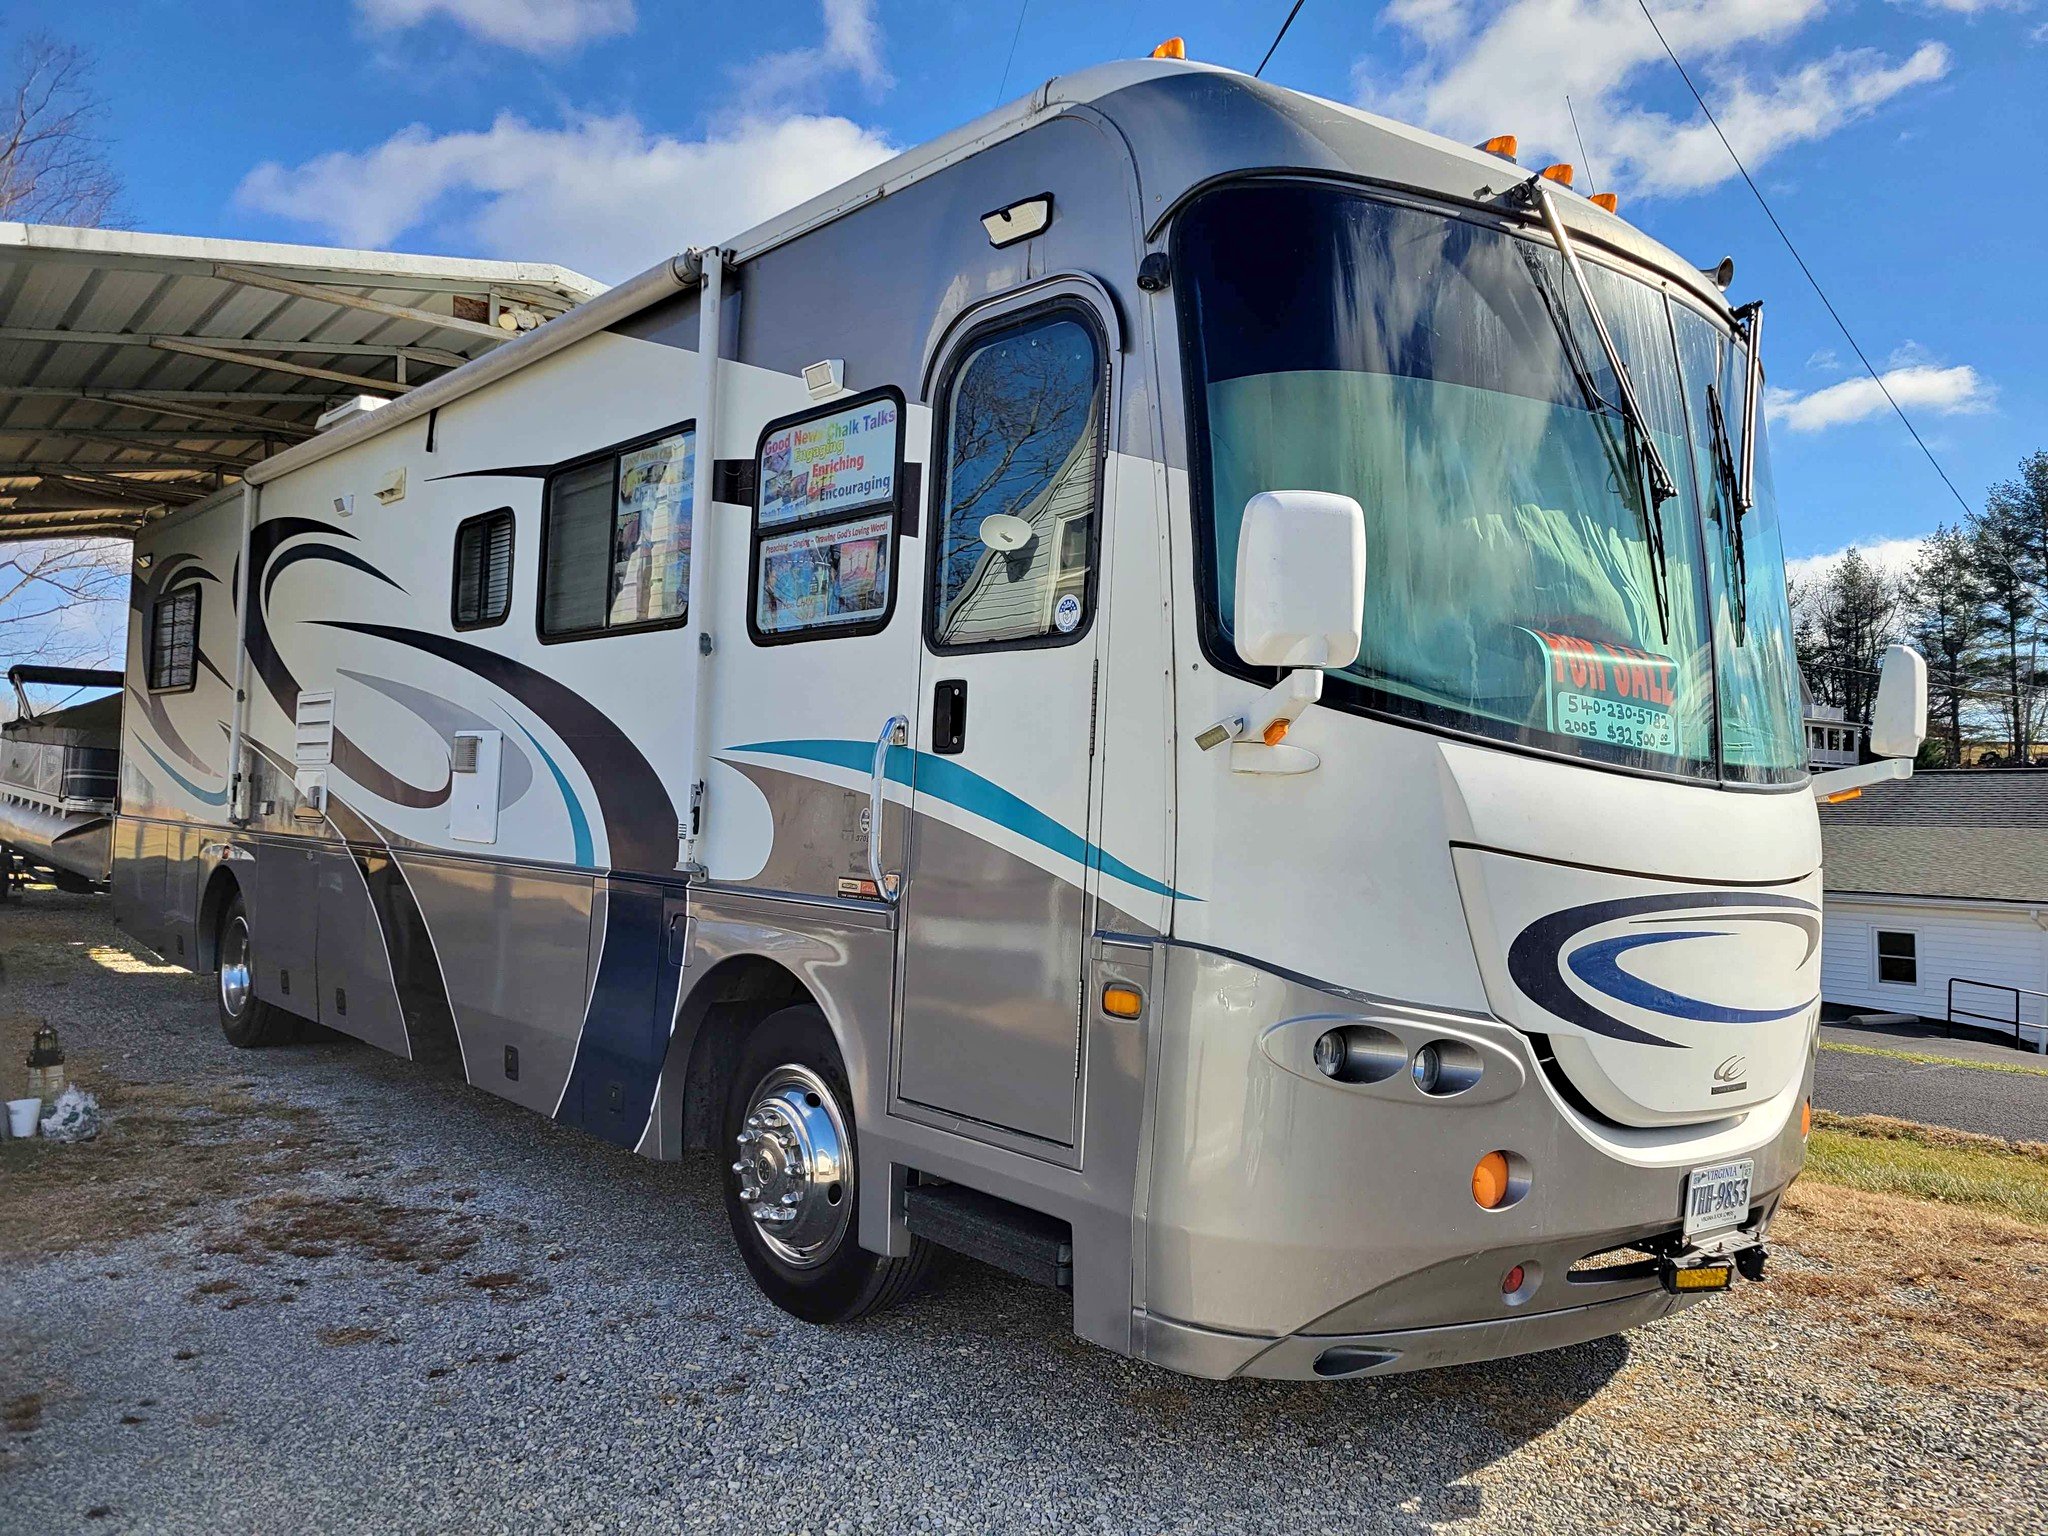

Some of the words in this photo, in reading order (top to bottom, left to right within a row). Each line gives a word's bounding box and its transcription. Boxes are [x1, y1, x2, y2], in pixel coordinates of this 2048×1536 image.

[765, 433, 791, 455] Good
[827, 418, 860, 439] Chalk
[863, 410, 896, 431] Talks
[794, 439, 845, 463] Engaging
[812, 455, 864, 478] Enriching
[820, 475, 891, 501] Encouraging
[852, 526, 870, 536] Loving
[1534, 629, 1606, 691] FOR
[1601, 641, 1674, 707] SALE
[1564, 719, 1598, 736] 2005
[1707, 1165, 1737, 1180] VIRGINIA
